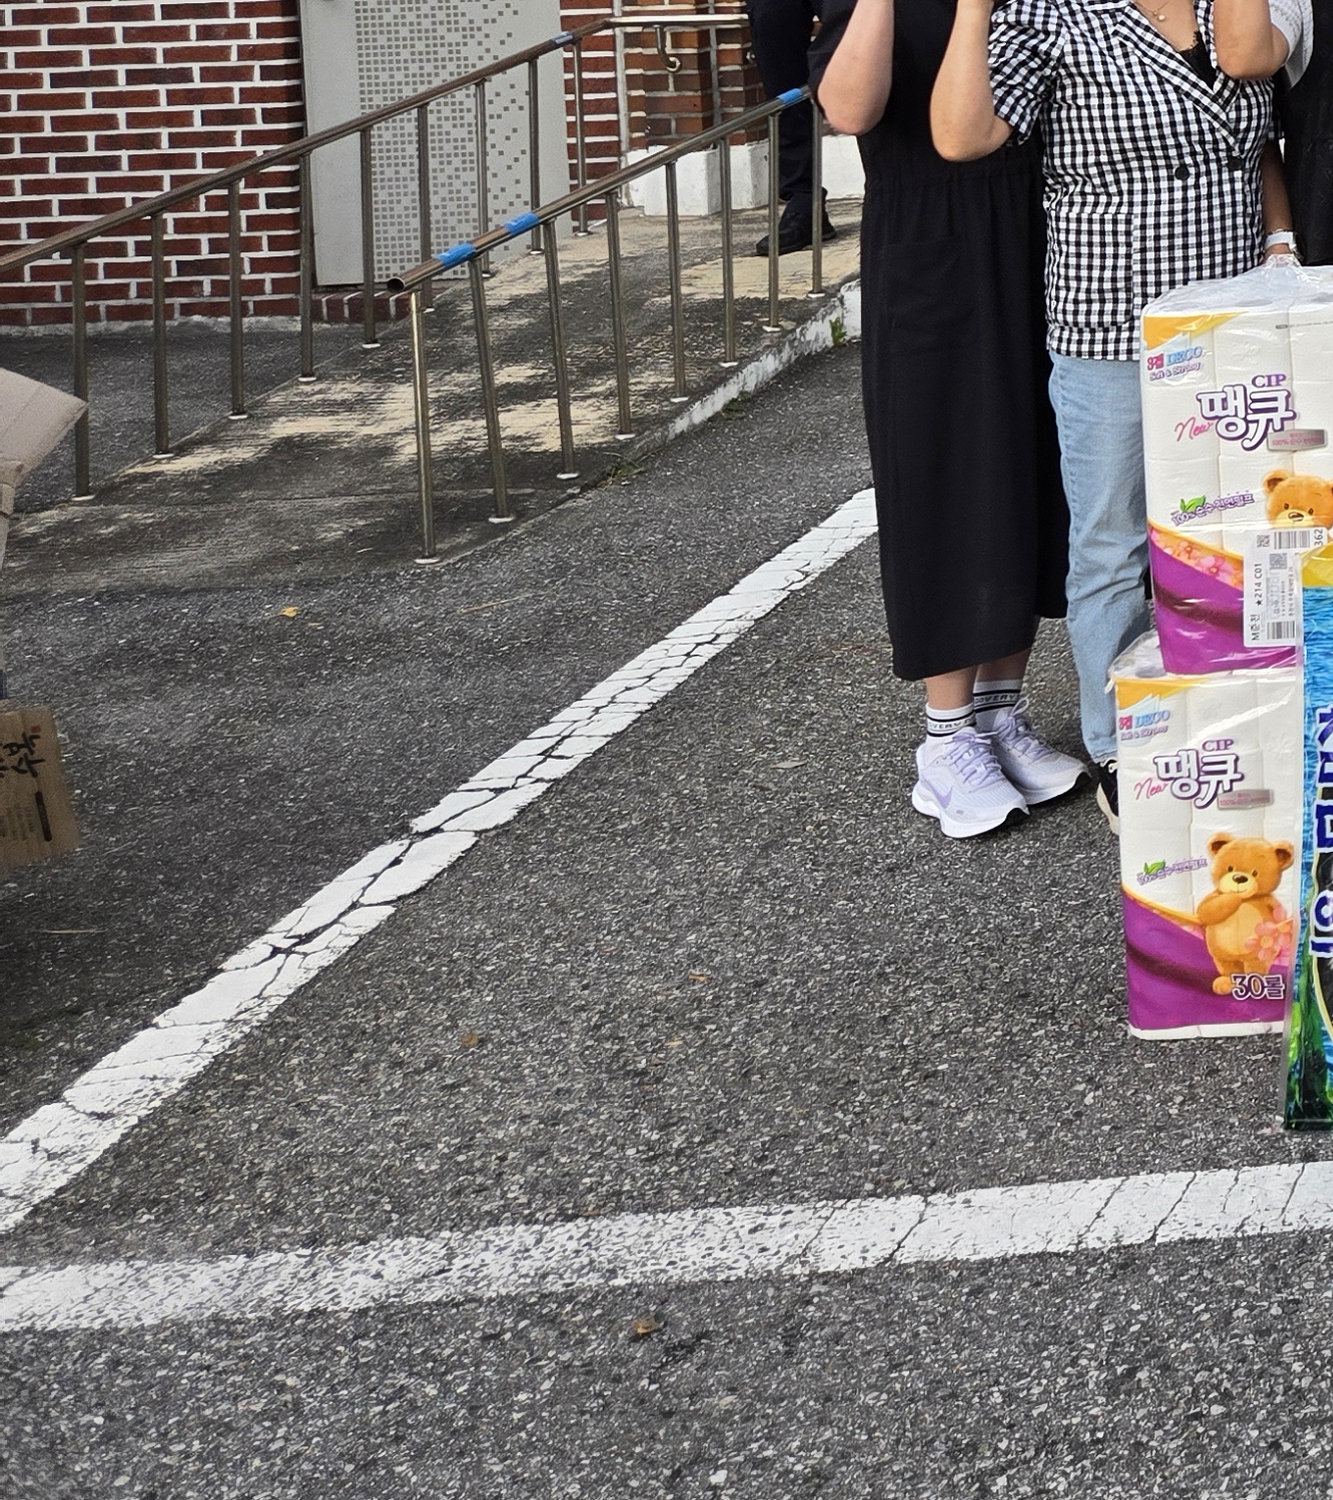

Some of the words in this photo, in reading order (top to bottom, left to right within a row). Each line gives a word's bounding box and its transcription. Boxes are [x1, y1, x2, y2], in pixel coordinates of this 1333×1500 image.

[1252, 374, 1286, 387] CIP
[1196, 384, 1297, 451] 땡큐
[1254, 563, 1262, 579] C01
[1202, 739, 1234, 751] CIP
[1153, 749, 1244, 809] 땡큐
[1231, 974, 1285, 1000] 30롤
